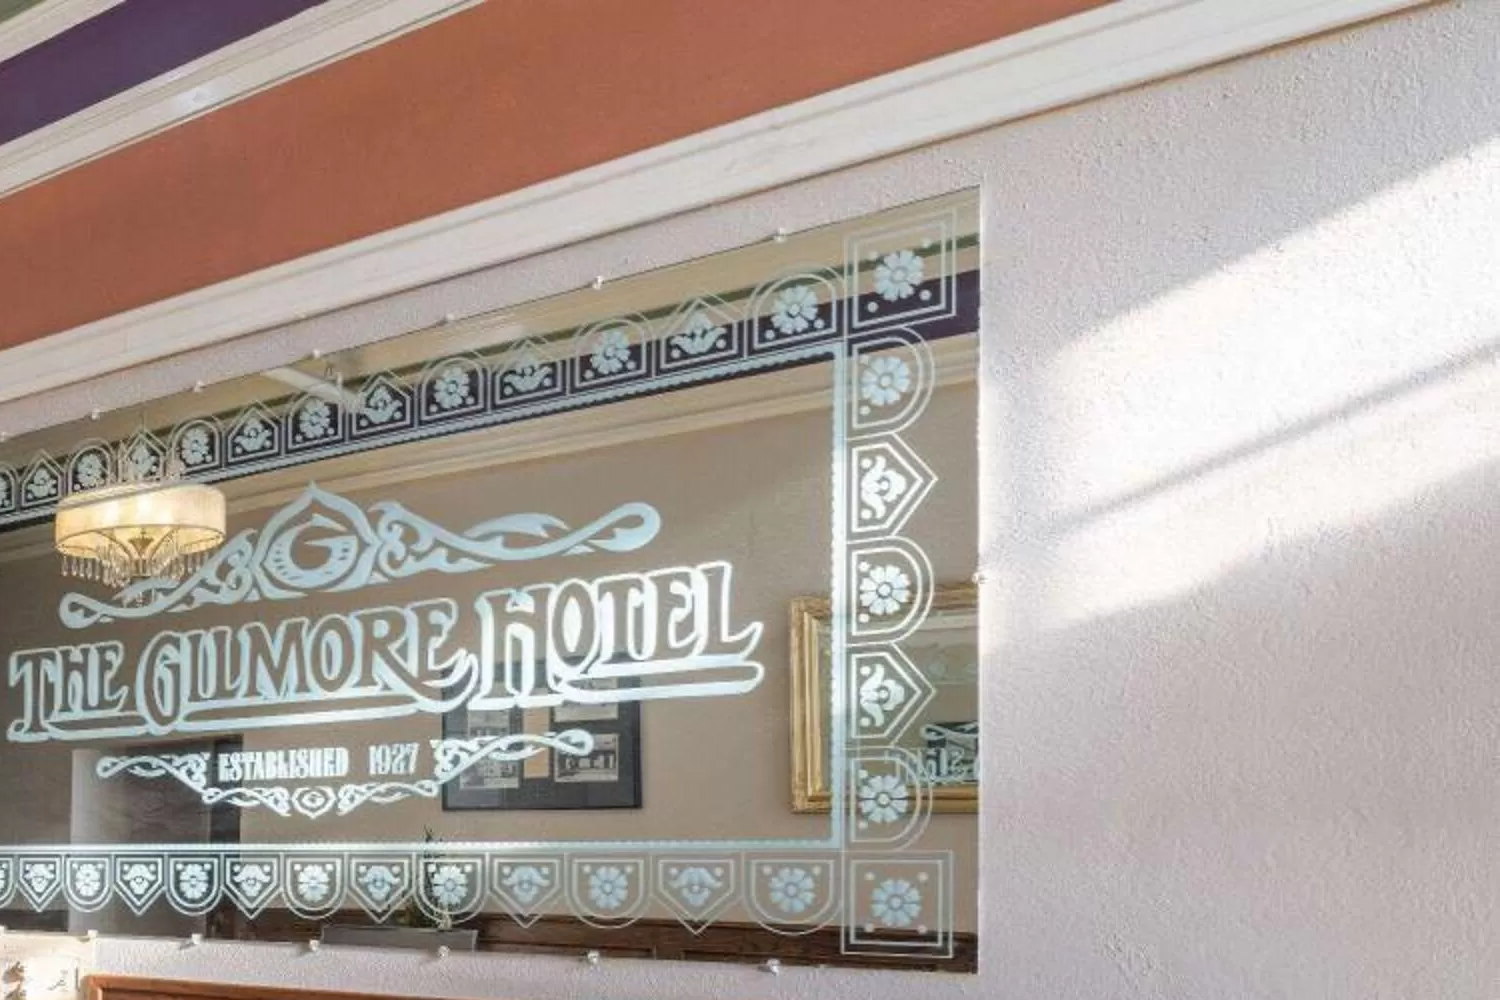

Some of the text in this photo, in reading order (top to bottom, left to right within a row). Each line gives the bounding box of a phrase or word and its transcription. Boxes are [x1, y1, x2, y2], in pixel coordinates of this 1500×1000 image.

[263, 512, 359, 590] G
[7, 560, 765, 742] THE GILMORE HOTEL
[217, 746, 349, 783] ESTABLISHED
